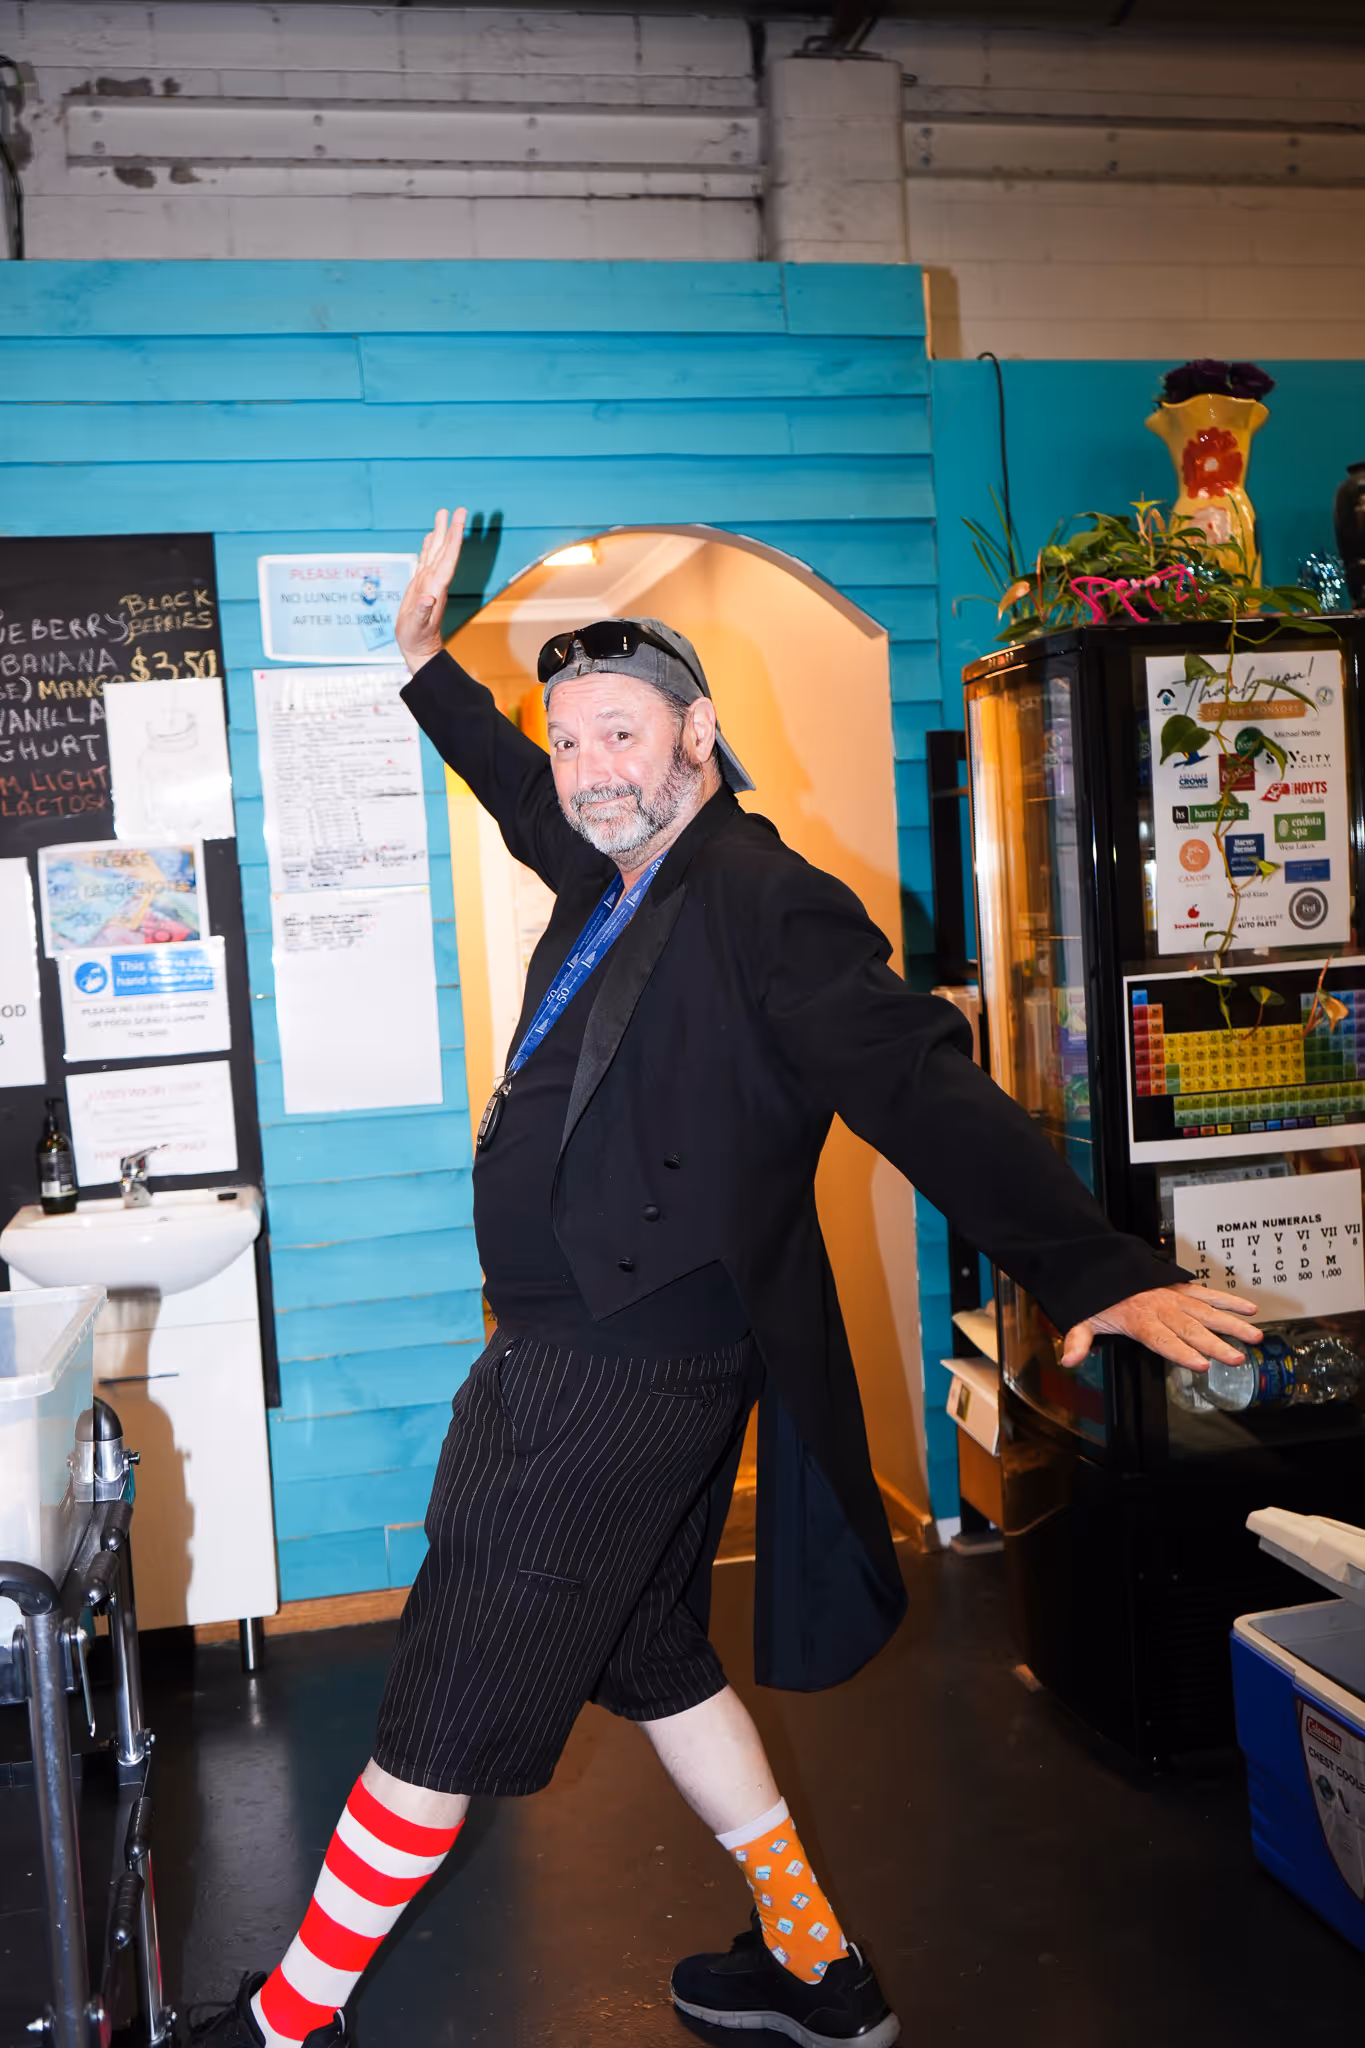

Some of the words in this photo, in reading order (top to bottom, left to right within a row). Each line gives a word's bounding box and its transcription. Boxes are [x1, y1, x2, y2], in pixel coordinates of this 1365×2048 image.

[119, 589, 214, 617] BLACK
[351, 590, 401, 602] OERS
[123, 610, 213, 646] BERRIES
[1, 647, 118, 677] BANANA
[1179, 777, 1208, 786] CROWS
[1294, 781, 1328, 795] HOYTS
[1176, 809, 1186, 819] hs
[1291, 815, 1322, 827] endota
[557, 987, 570, 1004] 50
[1217, 1220, 1257, 1232] ROMAN
[1262, 1214, 1322, 1228] NUMERALS
[1197, 1240, 1206, 1250] II
[1221, 1238, 1234, 1248] III
[1247, 1235, 1260, 1245] IV
[1274, 1233, 1283, 1242] V
[1297, 1230, 1310, 1240] VI
[1321, 1227, 1337, 1237] VII
[1201, 1254, 1206, 1262] 2
[1226, 1252, 1231, 1260] 3
[1252, 1249, 1257, 1257] 4
[1277, 1246, 1282, 1254] 5
[1302, 1243, 1307, 1251] 6
[1328, 1241, 1332, 1249] 7
[1353, 1237, 1357, 1245] 8
[1195, 1268, 1210, 1279] IX
[1225, 1266, 1235, 1276] X
[1253, 1263, 1260, 1273] L
[1275, 1260, 1284, 1270] C
[1301, 1258, 1309, 1268] D
[1326, 1255, 1336, 1265] M
[1227, 1279, 1236, 1288] 10
[1252, 1276, 1262, 1285] 50
[1273, 1274, 1287, 1284] 100
[1298, 1272, 1312, 1281] 500
[1321, 1267, 1342, 1279] 1,000
[1308, 1746, 1334, 1771] CHEST
